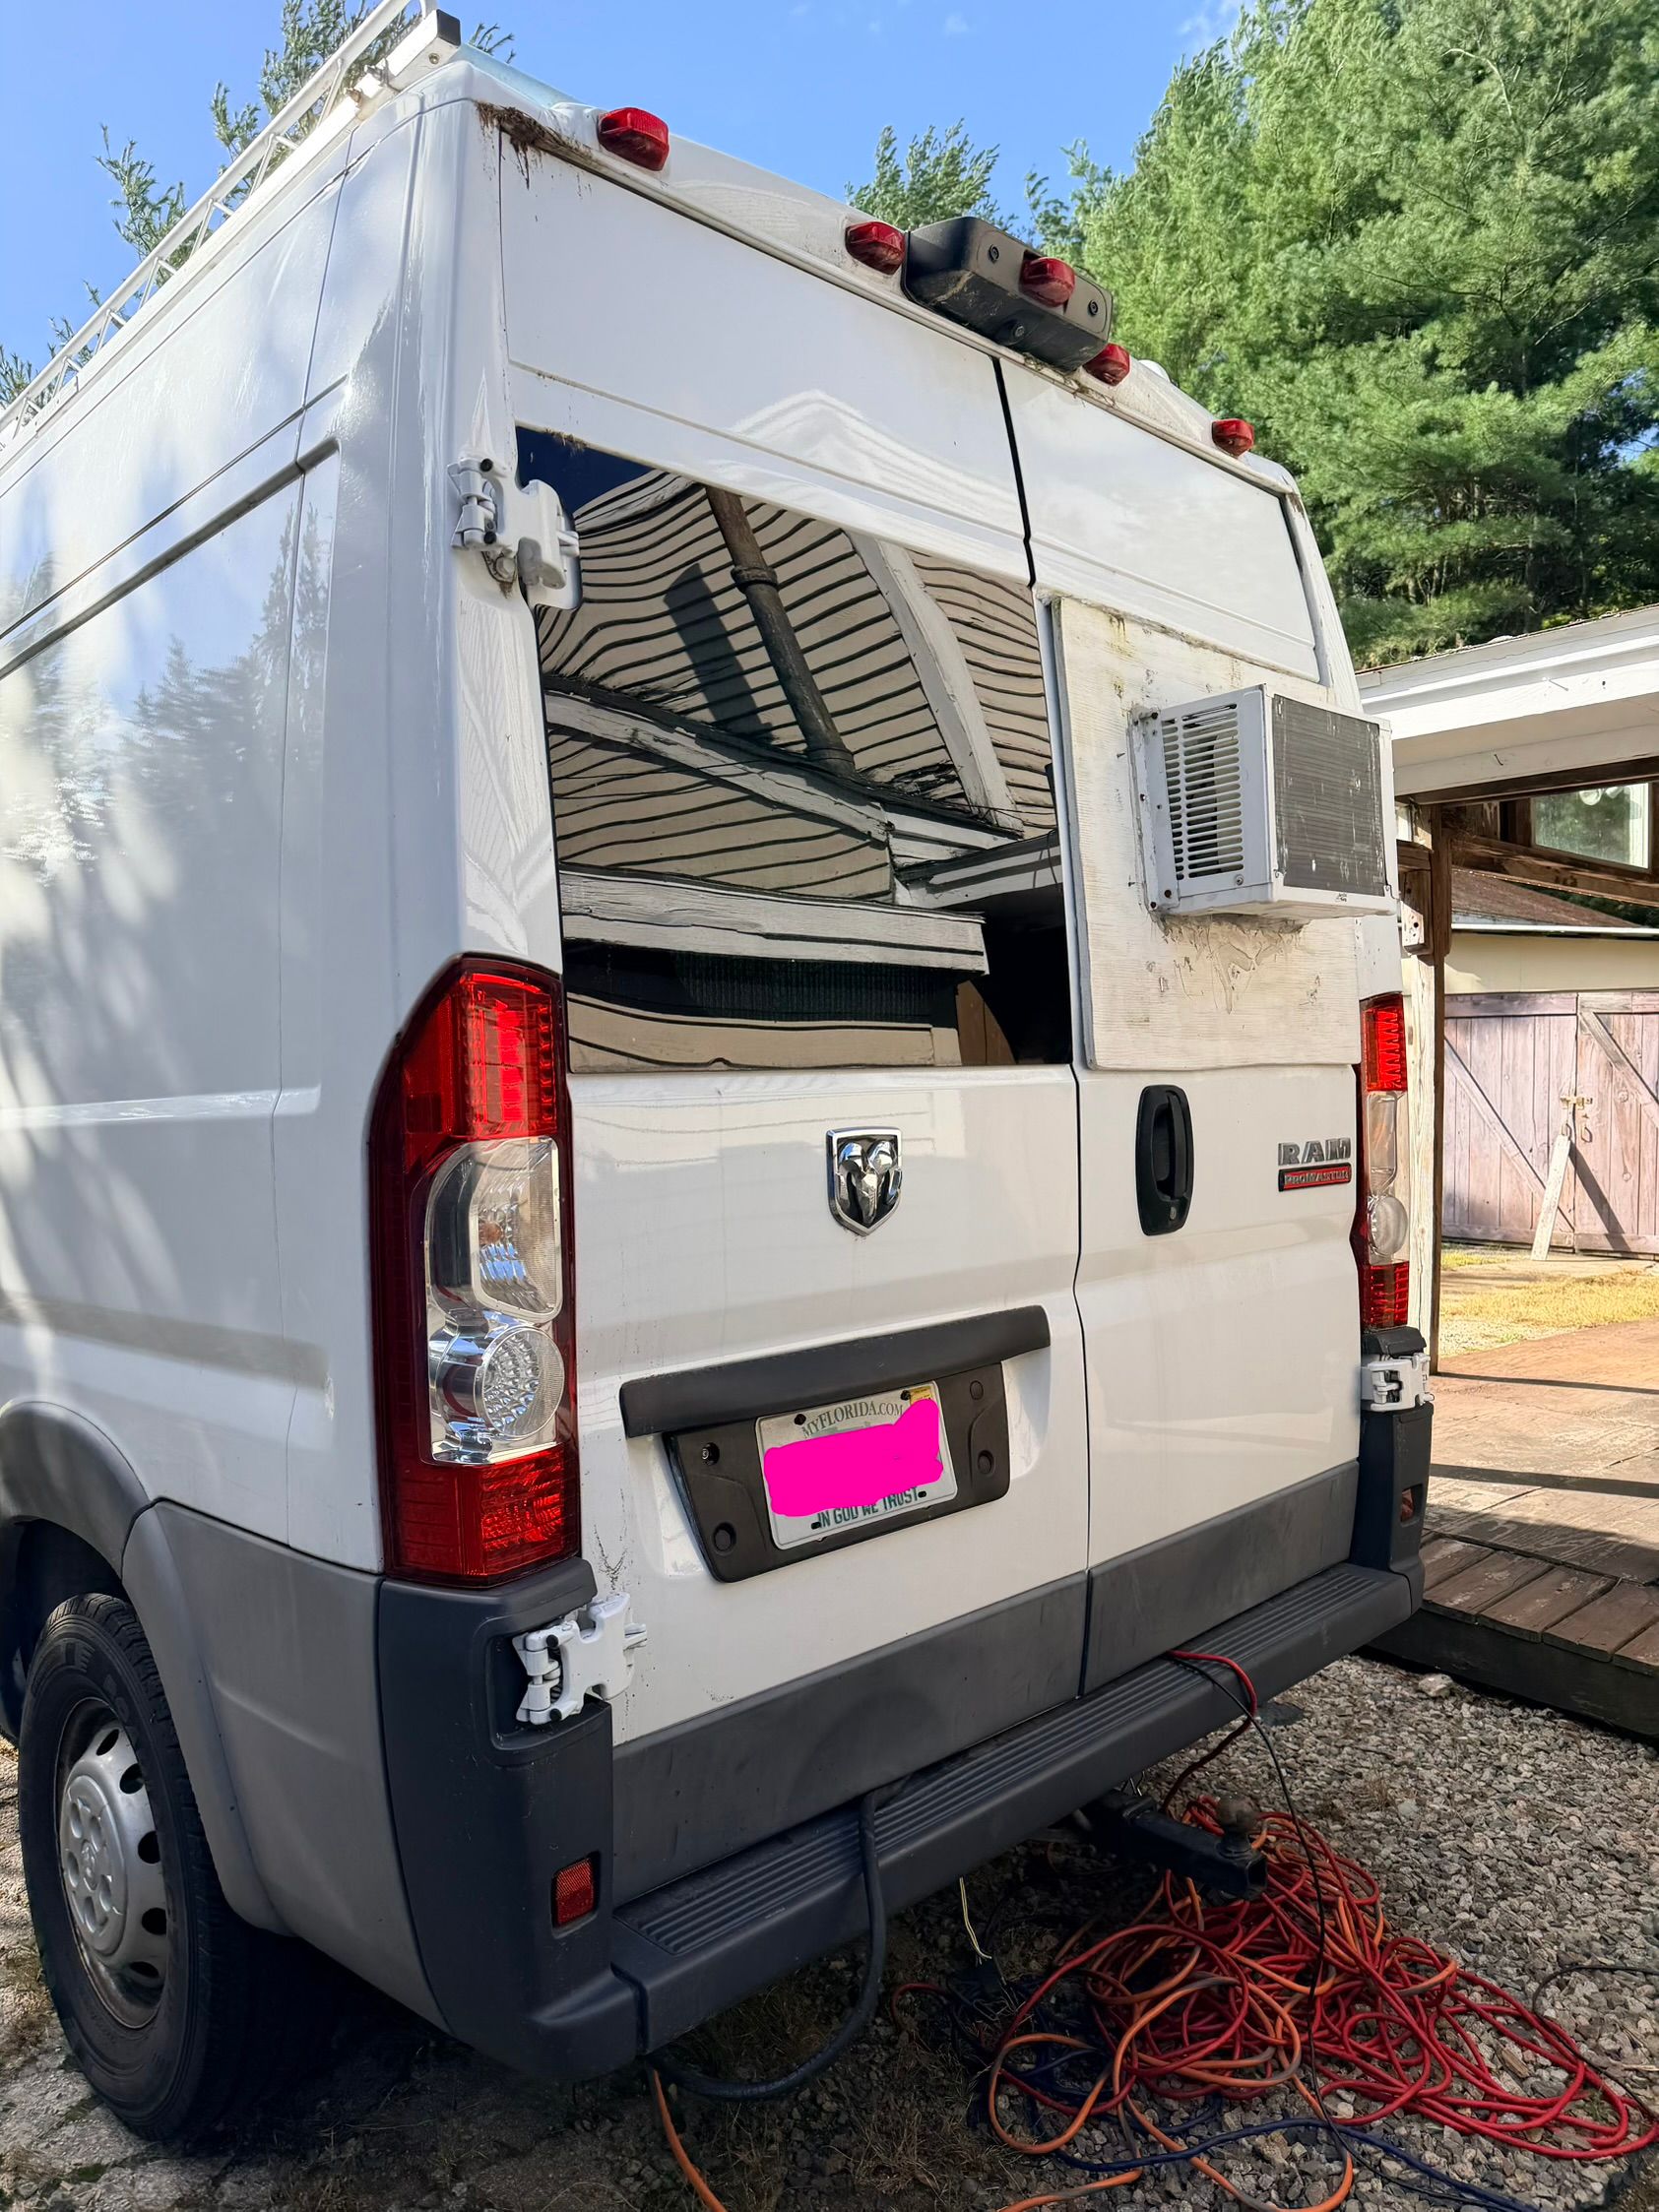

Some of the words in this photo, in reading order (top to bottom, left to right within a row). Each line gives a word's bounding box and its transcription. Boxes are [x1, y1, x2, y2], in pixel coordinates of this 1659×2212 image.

[1278, 1137, 1351, 1166] RAM
[801, 1401, 903, 1439] MYFLORIDA.COM
[818, 1510, 831, 1528] IN
[833, 1506, 859, 1524] GOD
[883, 1487, 919, 1510] TRUST
